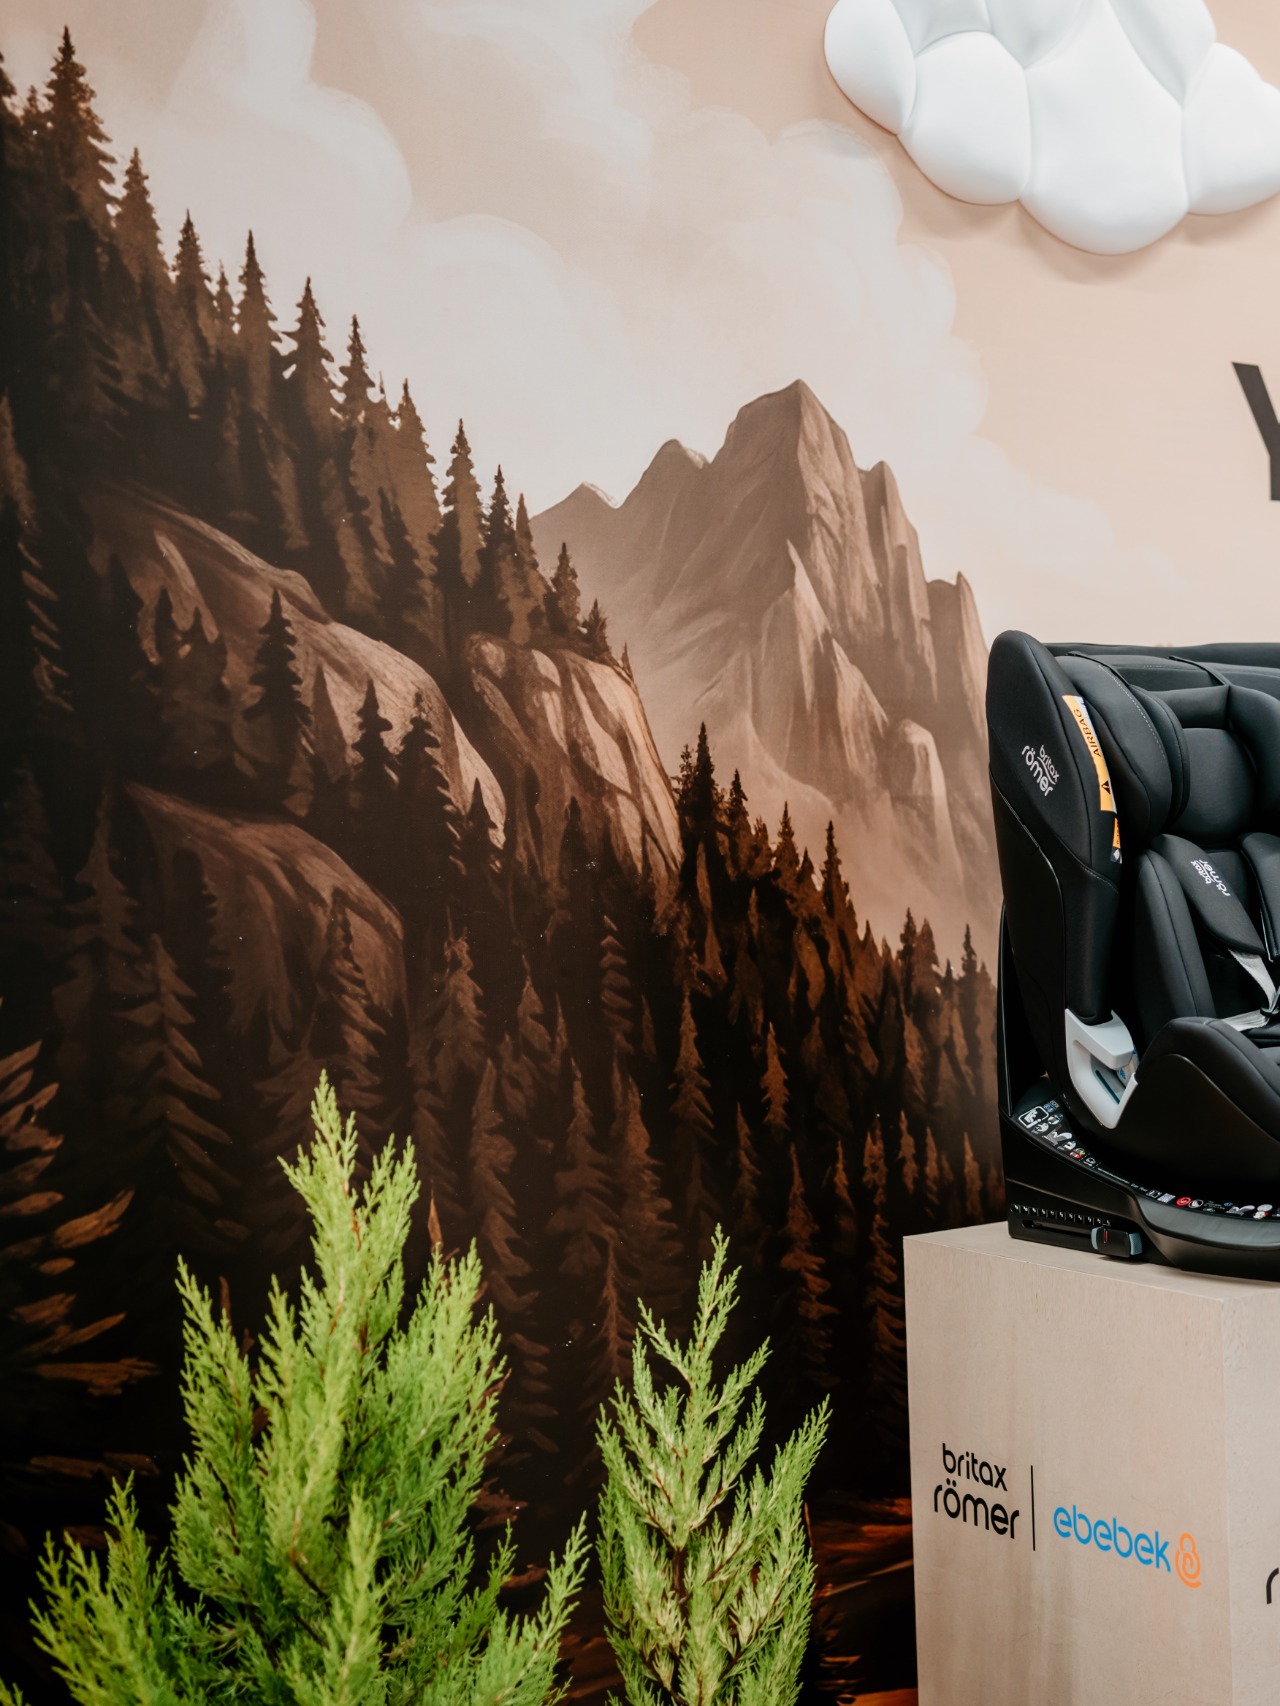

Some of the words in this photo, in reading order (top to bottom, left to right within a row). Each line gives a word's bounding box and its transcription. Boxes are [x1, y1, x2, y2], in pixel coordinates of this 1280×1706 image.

[1073, 708, 1102, 757] AIRBAG
[1021, 745, 1054, 796] römer
[1040, 744, 1060, 783] britax
[942, 1442, 1008, 1491] britax
[933, 1478, 1019, 1539] römer
[1053, 1505, 1171, 1573] ebebek
